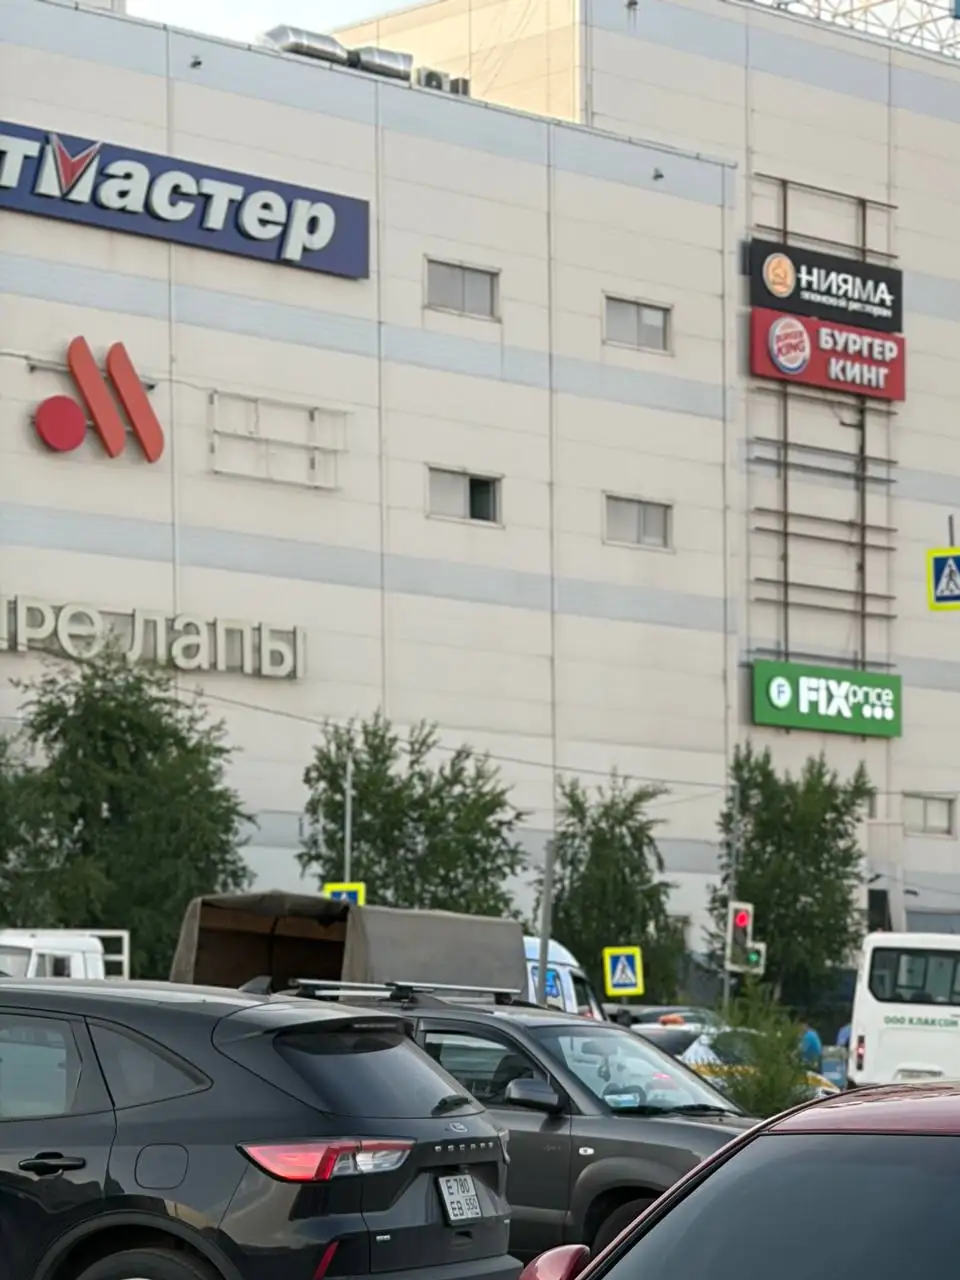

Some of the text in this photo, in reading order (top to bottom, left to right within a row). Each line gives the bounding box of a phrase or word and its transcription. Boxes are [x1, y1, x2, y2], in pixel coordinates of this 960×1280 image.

[799, 264, 894, 306] НИЯМА
[819, 328, 898, 361] БУРГЕР
[829, 357, 888, 388] КИНГ
[130, 609, 306, 678] лапы
[884, 1015, 906, 1026] ООО
